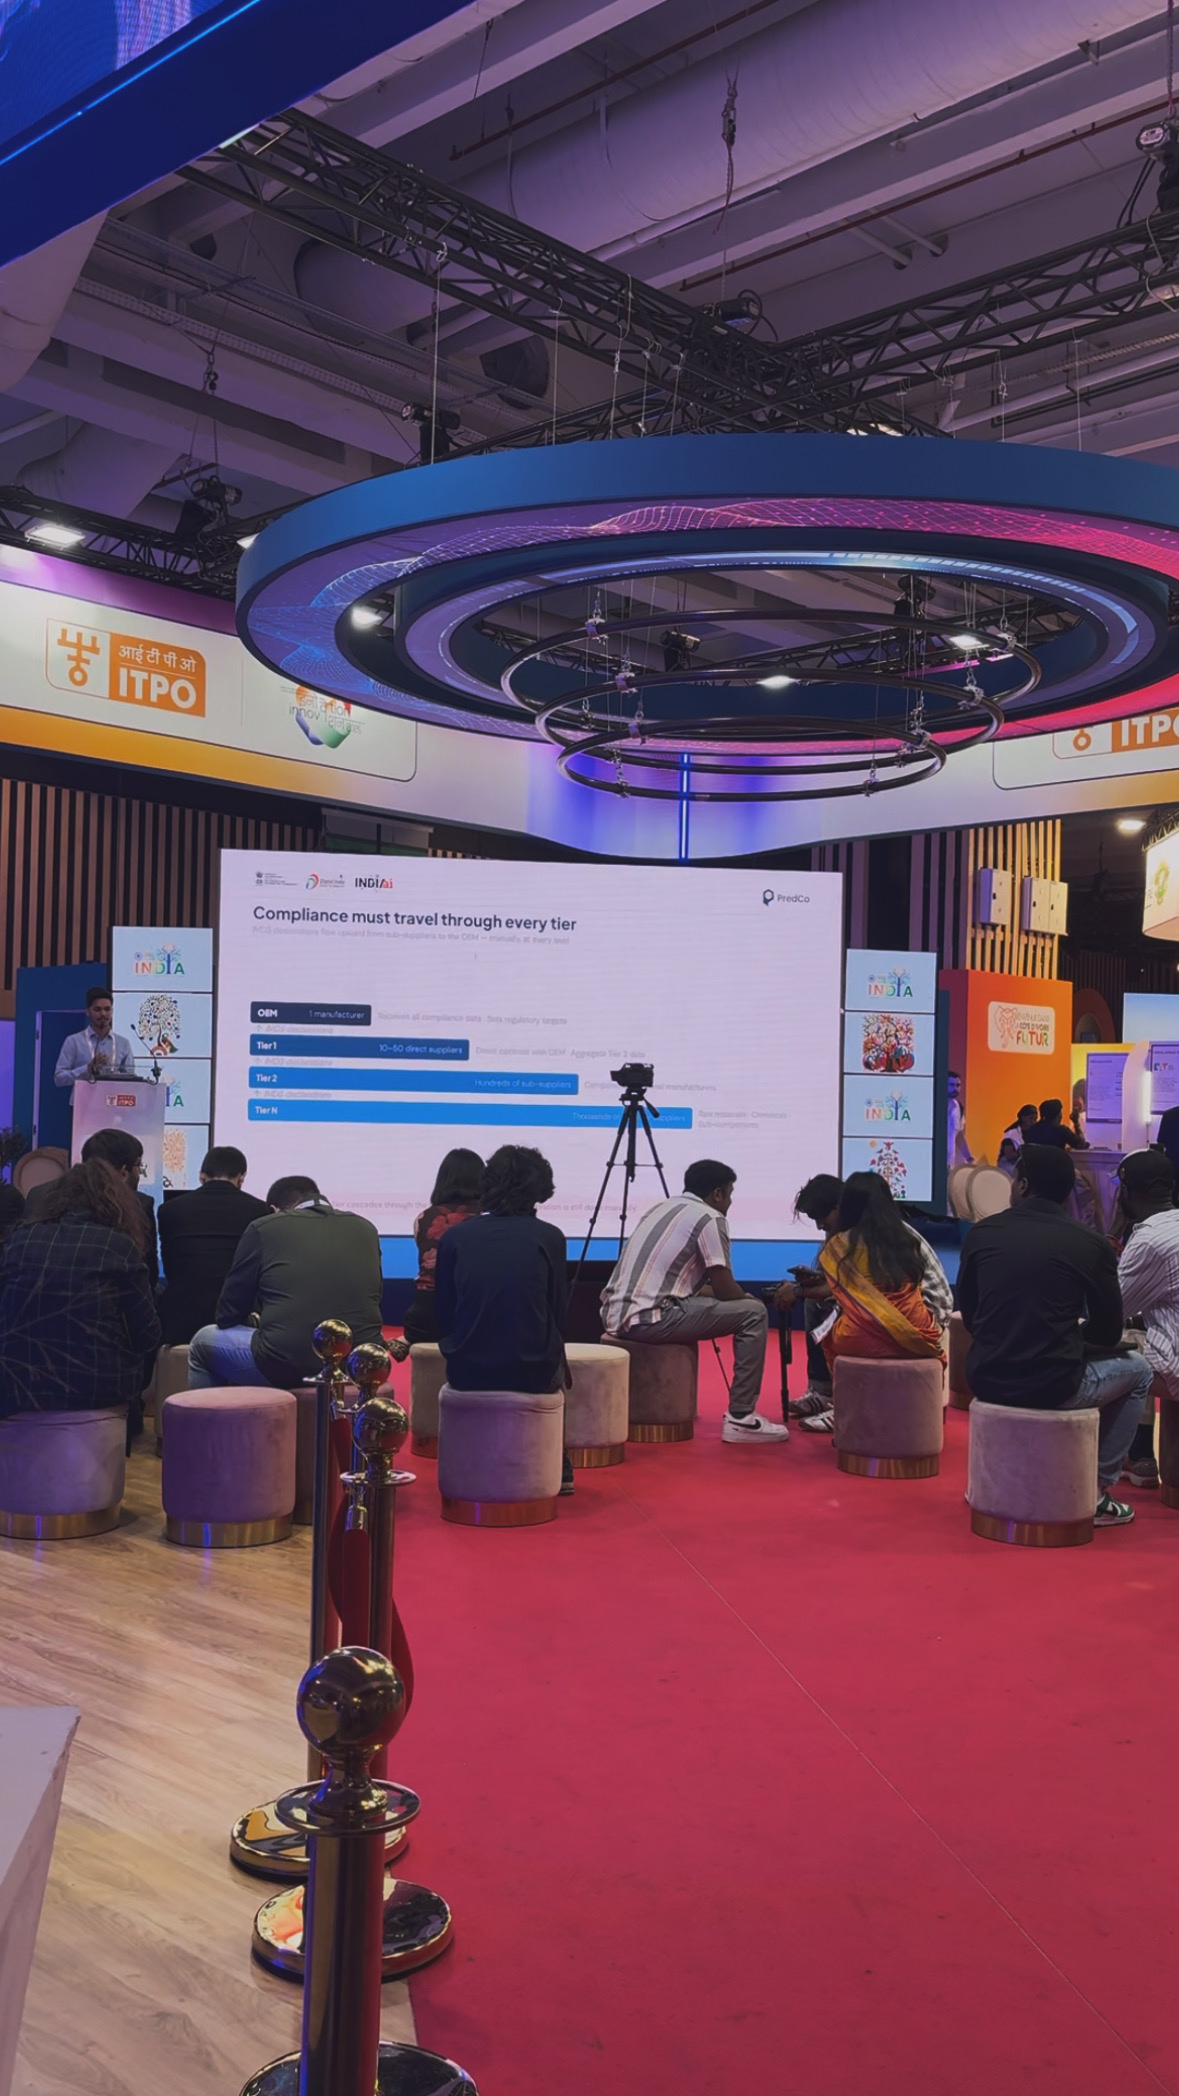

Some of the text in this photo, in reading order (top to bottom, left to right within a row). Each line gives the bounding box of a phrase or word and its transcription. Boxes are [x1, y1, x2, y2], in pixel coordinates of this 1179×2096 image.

[118, 644, 197, 672] आई टी पी ओ
[119, 667, 197, 709] ITPO
[777, 894, 811, 903] PredCo
[253, 905, 577, 933] Compliance must travel through every tier
[135, 955, 185, 975] INDIA
[868, 979, 913, 998] INDIA
[257, 1008, 278, 1018] OEM
[314, 1010, 365, 1019] manufacturer
[1016, 1030, 1049, 1047] FUTUR
[256, 1041, 273, 1050] Tier
[405, 1045, 427, 1053] direct
[429, 1046, 463, 1055] suppliers
[256, 1074, 271, 1083] Tier
[475, 1079, 571, 1090] Hundreds of sub-suppliers
[255, 1106, 271, 1115] Tier
[865, 1103, 911, 1121] INDIA
